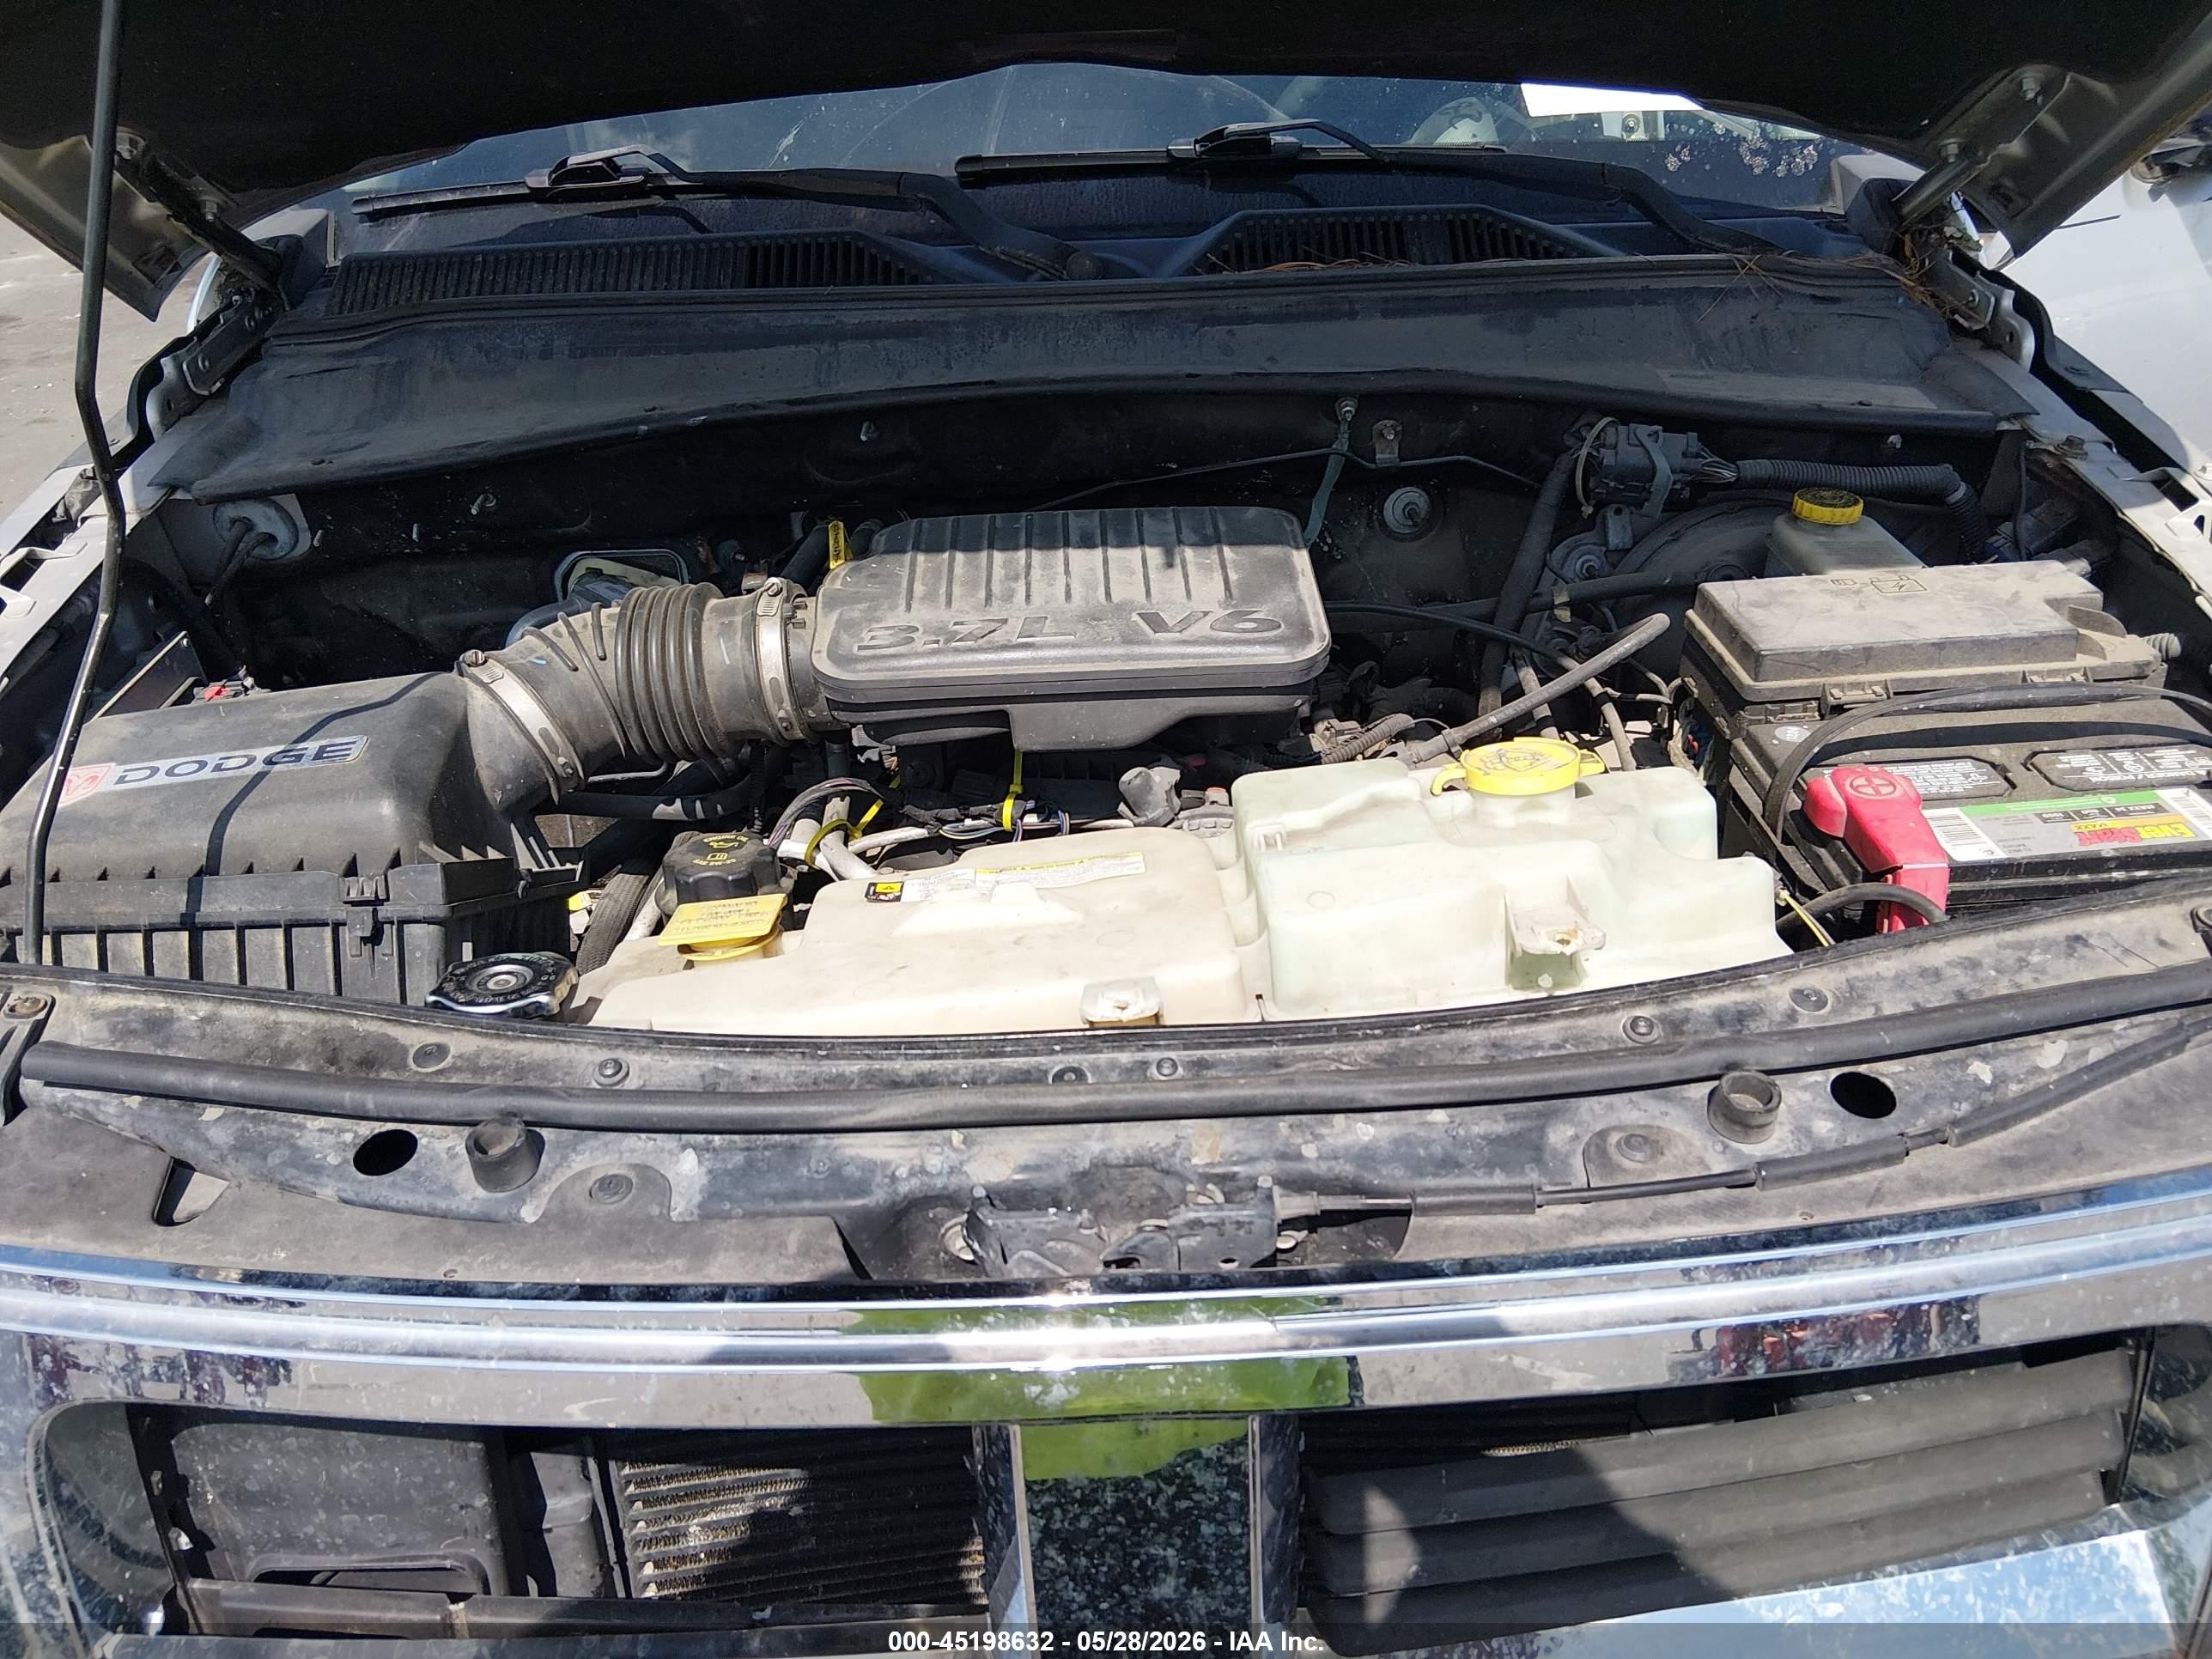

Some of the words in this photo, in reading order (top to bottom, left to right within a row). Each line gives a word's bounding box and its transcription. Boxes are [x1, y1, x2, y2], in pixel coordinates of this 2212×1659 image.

[856, 615, 1076, 652] 3.7L
[1132, 609, 1284, 637] V6
[113, 739, 357, 786] DODGE
[2074, 822, 2197, 847] EverStart
